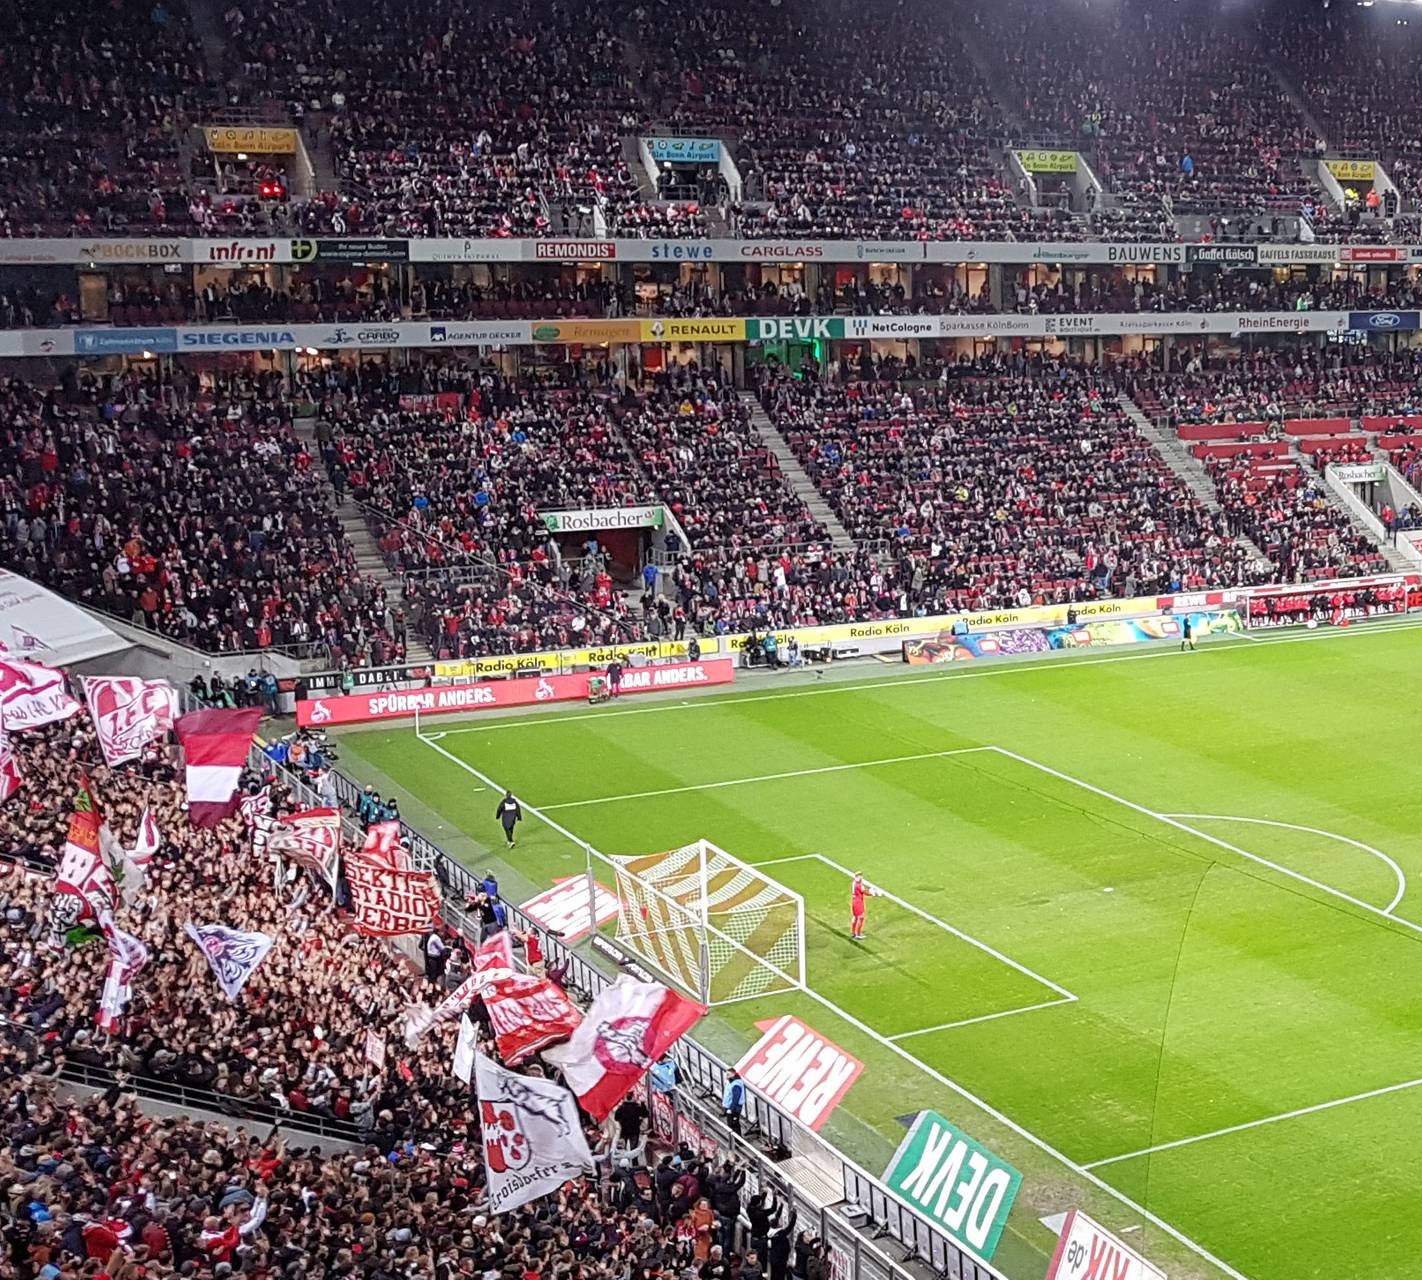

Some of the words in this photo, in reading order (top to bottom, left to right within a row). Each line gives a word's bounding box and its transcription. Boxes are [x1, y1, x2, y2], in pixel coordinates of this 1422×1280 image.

[258, 141, 291, 151] Airport
[688, 151, 714, 160] Airport
[537, 243, 609, 257] REMONDIS
[652, 244, 713, 258] stewe
[741, 246, 823, 257] CARGLASS
[1108, 246, 1182, 260] BAUWENS
[1199, 247, 1225, 260] Gaffel
[1260, 249, 1289, 259] GAFFELS
[872, 322, 932, 334] NetCologne
[940, 321, 985, 332] Sparkasse
[1059, 317, 1094, 326] EVENT
[1238, 317, 1310, 330] RheinEnergie
[670, 324, 736, 335] RENAULT
[758, 318, 831, 340] DEVK
[183, 332, 295, 345] SIEGENIA
[357, 331, 400, 341] CARBO
[448, 332, 487, 340] AGENTUR
[1338, 468, 1377, 480] Rosbacher
[561, 512, 642, 530] Rosbacher
[1099, 603, 1121, 614] Köln
[962, 613, 993, 626] Radio
[995, 613, 1019, 624] Köln
[850, 626, 882, 638] Radio
[885, 622, 910, 634] Köln
[476, 659, 514, 674] Radio
[517, 656, 546, 669] Köln
[653, 666, 708, 685] ANDERS.
[369, 692, 435, 715] SPÜRBAR
[438, 686, 496, 707] ANDERS.
[744, 1022, 856, 1126] REWE
[900, 1121, 1011, 1250] DEVK
